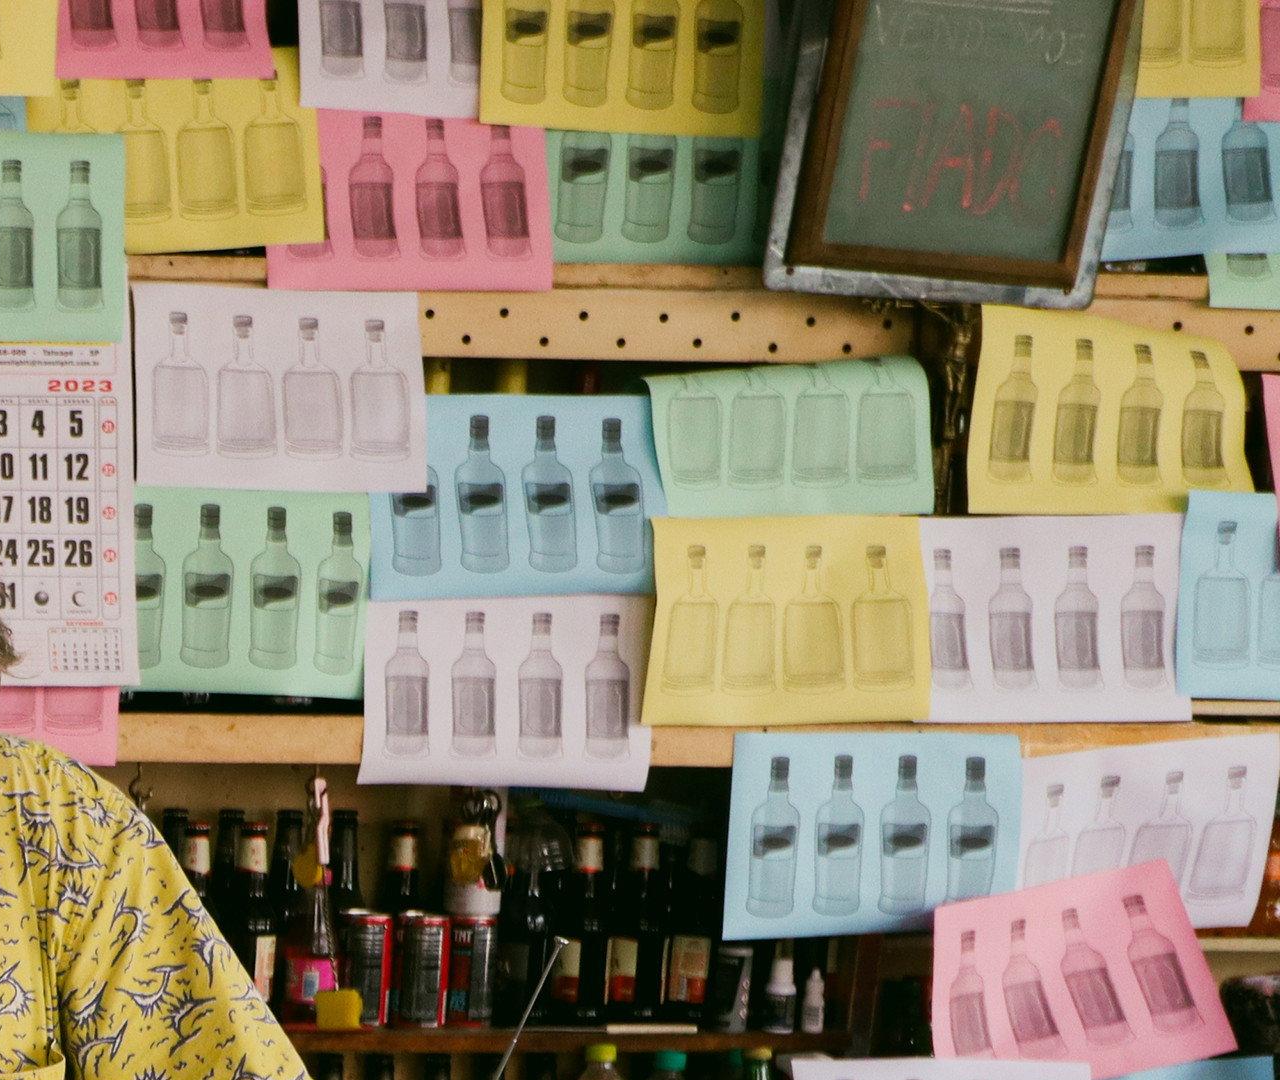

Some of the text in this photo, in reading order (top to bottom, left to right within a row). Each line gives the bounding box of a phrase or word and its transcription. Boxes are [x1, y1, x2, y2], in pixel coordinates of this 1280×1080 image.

[856, 97, 1065, 222] FIADO
[48, 380, 113, 393] 2023
[31, 410, 45, 438] 4
[69, 410, 83, 438] 5
[29, 453, 48, 480] 11
[64, 453, 89, 481] 12
[28, 496, 52, 524] 18
[64, 496, 89, 524] 19
[27, 539, 55, 567] 25
[64, 539, 92, 568] 26
